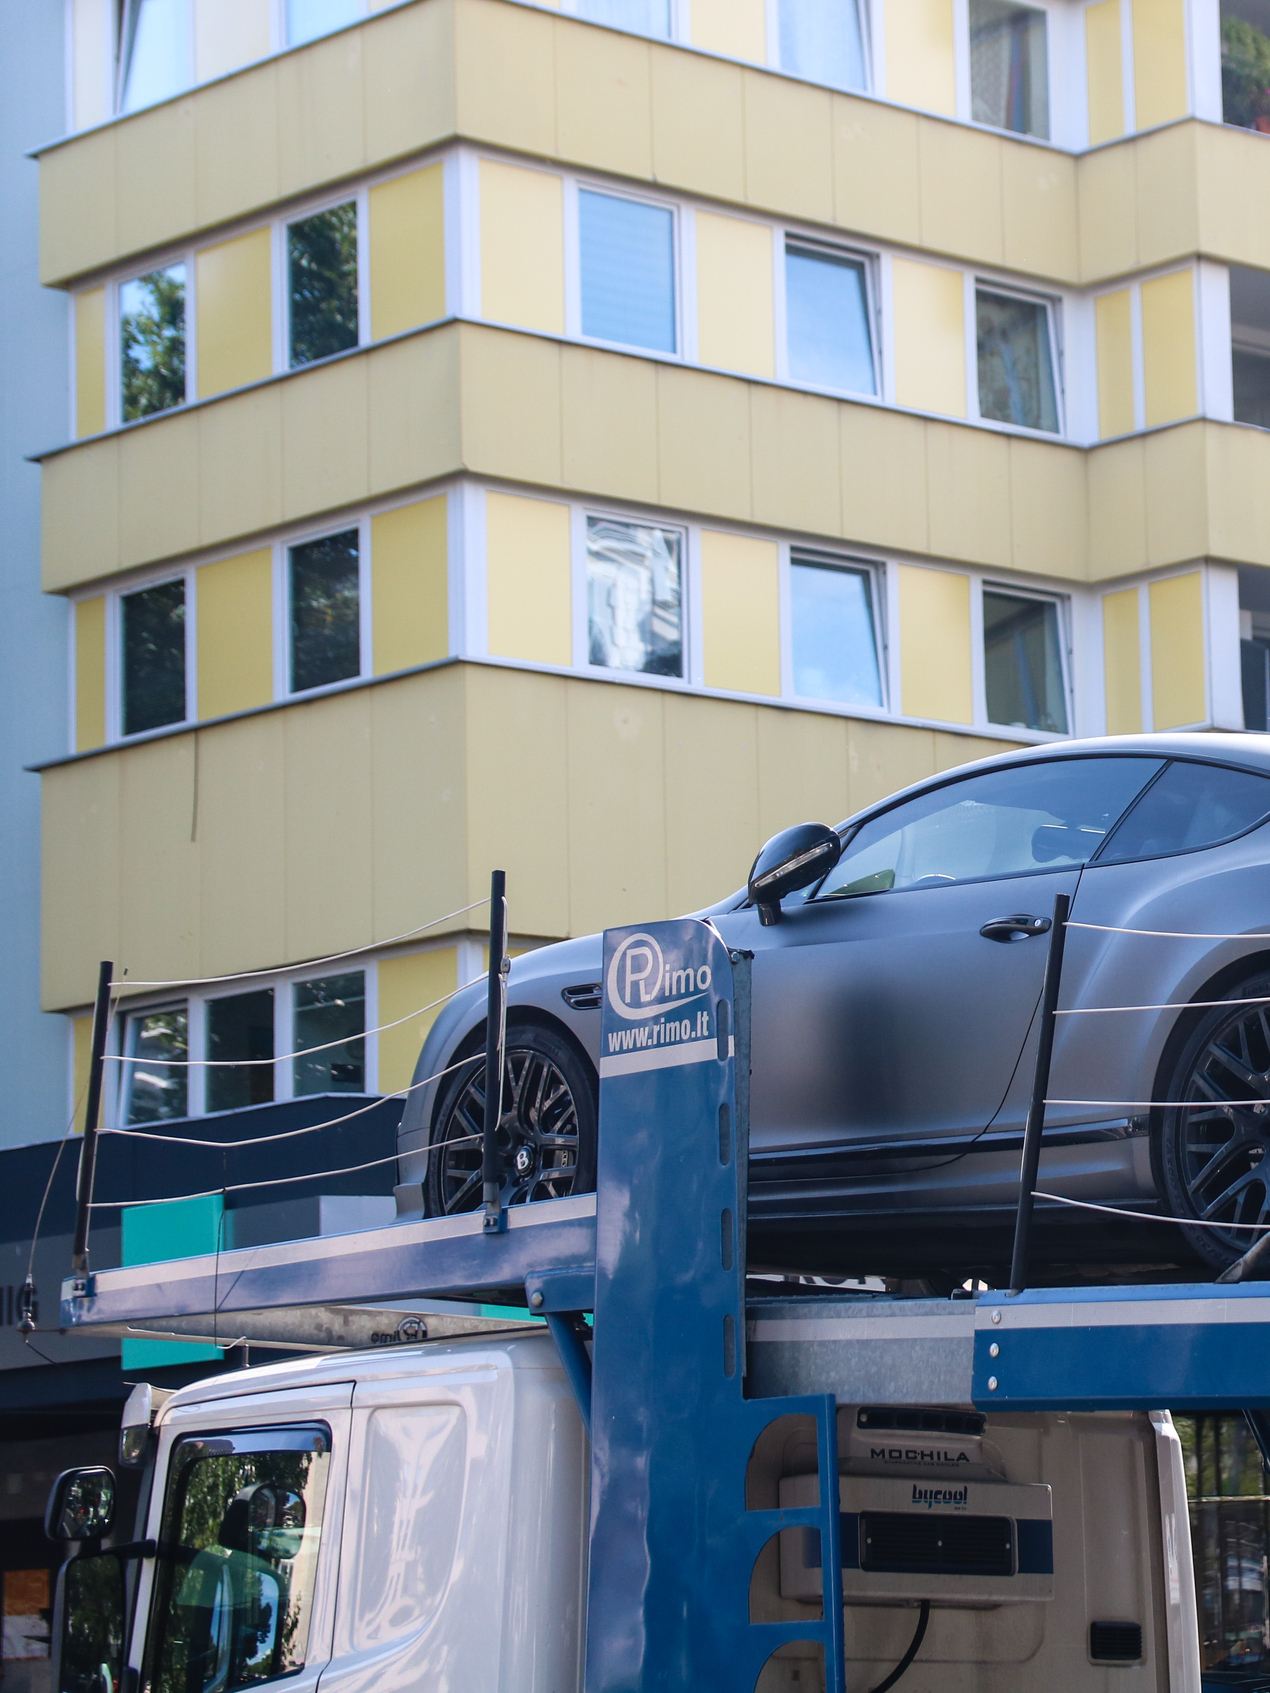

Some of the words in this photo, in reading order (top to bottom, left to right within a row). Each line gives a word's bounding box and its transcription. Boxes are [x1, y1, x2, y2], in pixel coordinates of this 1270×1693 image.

[621, 943, 712, 1005] Rimo
[607, 1010, 709, 1053] www.rimo.lt
[870, 1448, 970, 1462] MOCHILA
[911, 1483, 968, 1510] bycool
